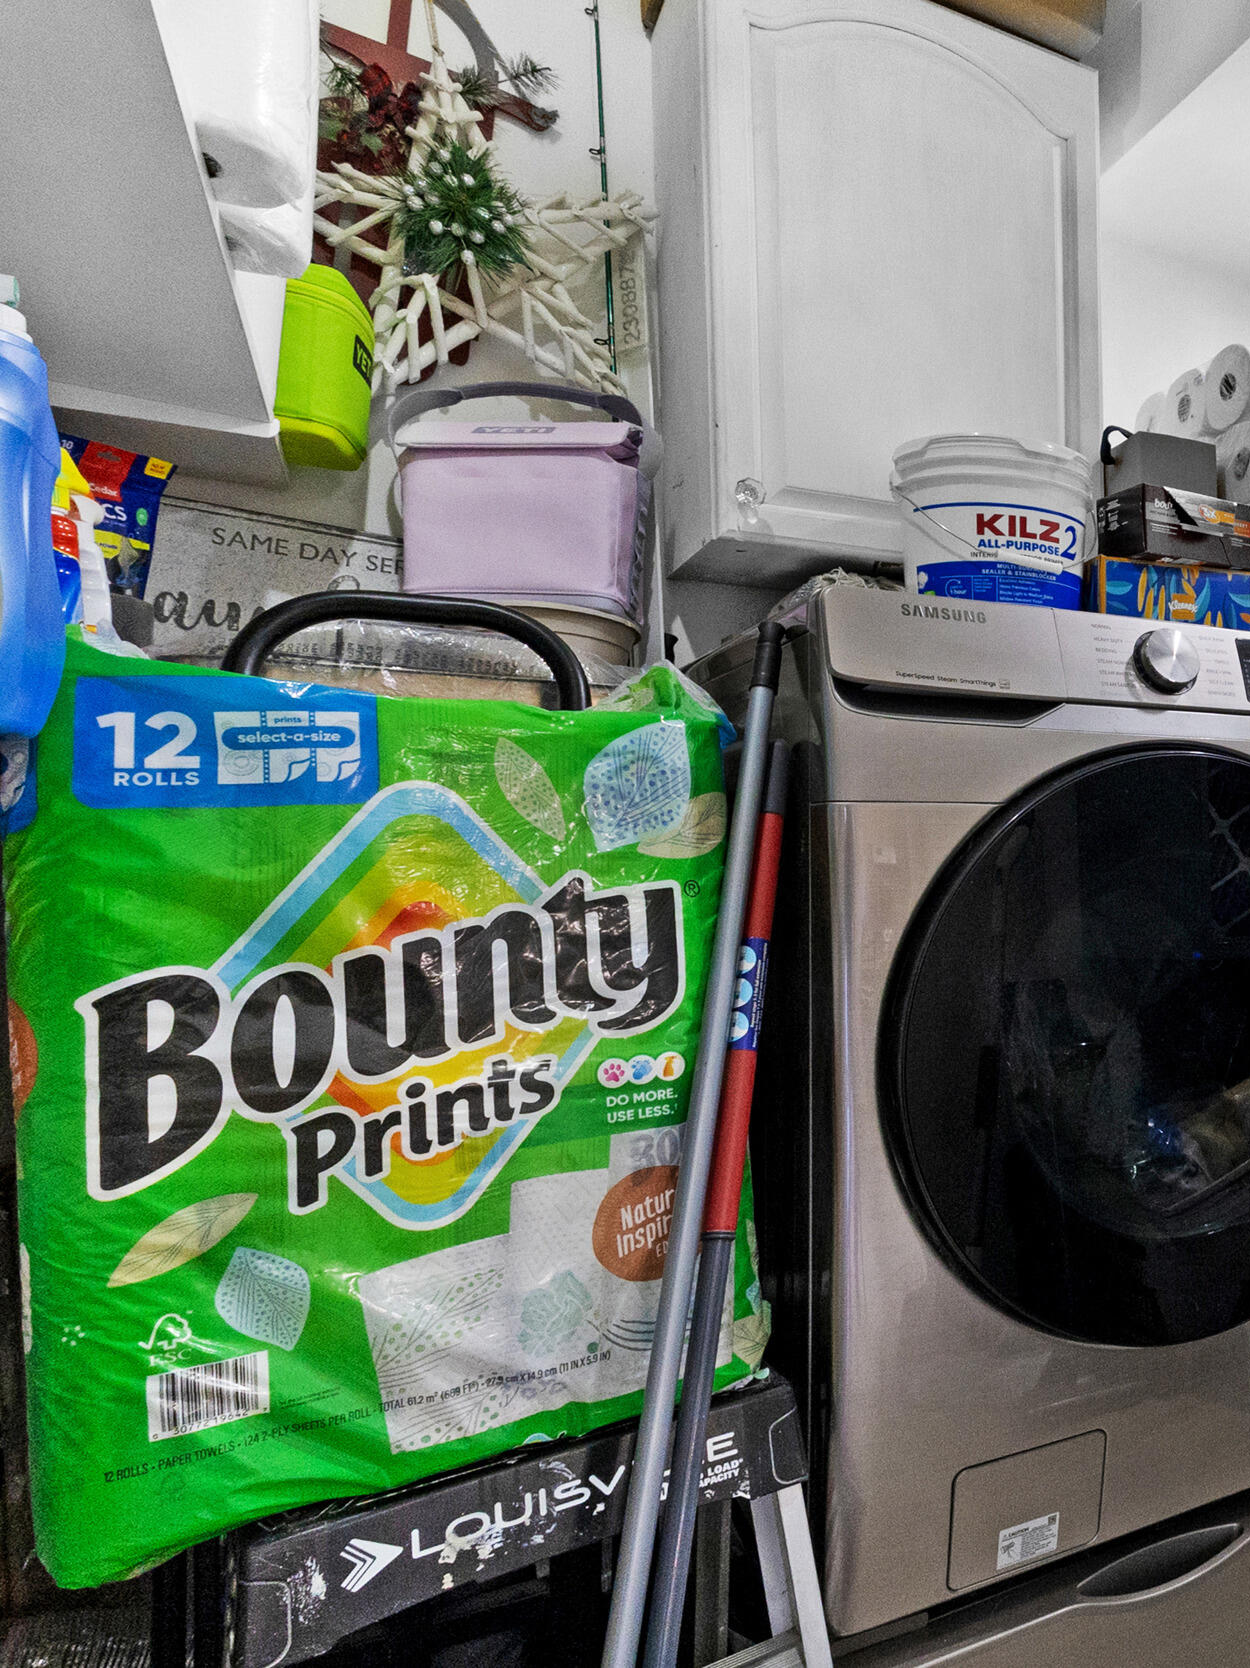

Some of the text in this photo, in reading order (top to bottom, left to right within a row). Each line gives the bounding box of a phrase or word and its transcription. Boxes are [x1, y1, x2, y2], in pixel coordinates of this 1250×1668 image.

[211, 527, 290, 556] SAME
[299, 543, 358, 567] DAY
[976, 513, 1060, 544] KILZ
[1060, 525, 1078, 561] 2
[977, 539, 1061, 556] ALL-PURPOSE
[901, 603, 987, 624] SAMSUNG
[1168, 600, 1199, 614] Kleenex
[895, 670, 935, 682] SuperSpeed
[959, 678, 997, 688] SmartThings
[273, 715, 302, 724] prints
[95, 711, 200, 769] 12
[237, 731, 341, 744] select-a-size
[113, 771, 200, 787] ROLLS
[88, 874, 682, 1194] Bounty
[606, 1088, 678, 1107] DO MORE.
[607, 1109, 635, 1123] USE
[292, 1056, 557, 1208] Prints
[104, 1470, 116, 1483] 12
[116, 1462, 149, 1481] ROLLS
[158, 1452, 192, 1471] PAPER
[194, 1440, 236, 1461] TOWELS
[328, 1413, 347, 1427] PER
[348, 1406, 372, 1422] ROLL
[378, 1399, 406, 1414] TOTAL
[544, 1367, 558, 1377] cm
[699, 1467, 740, 1488] APACITY
